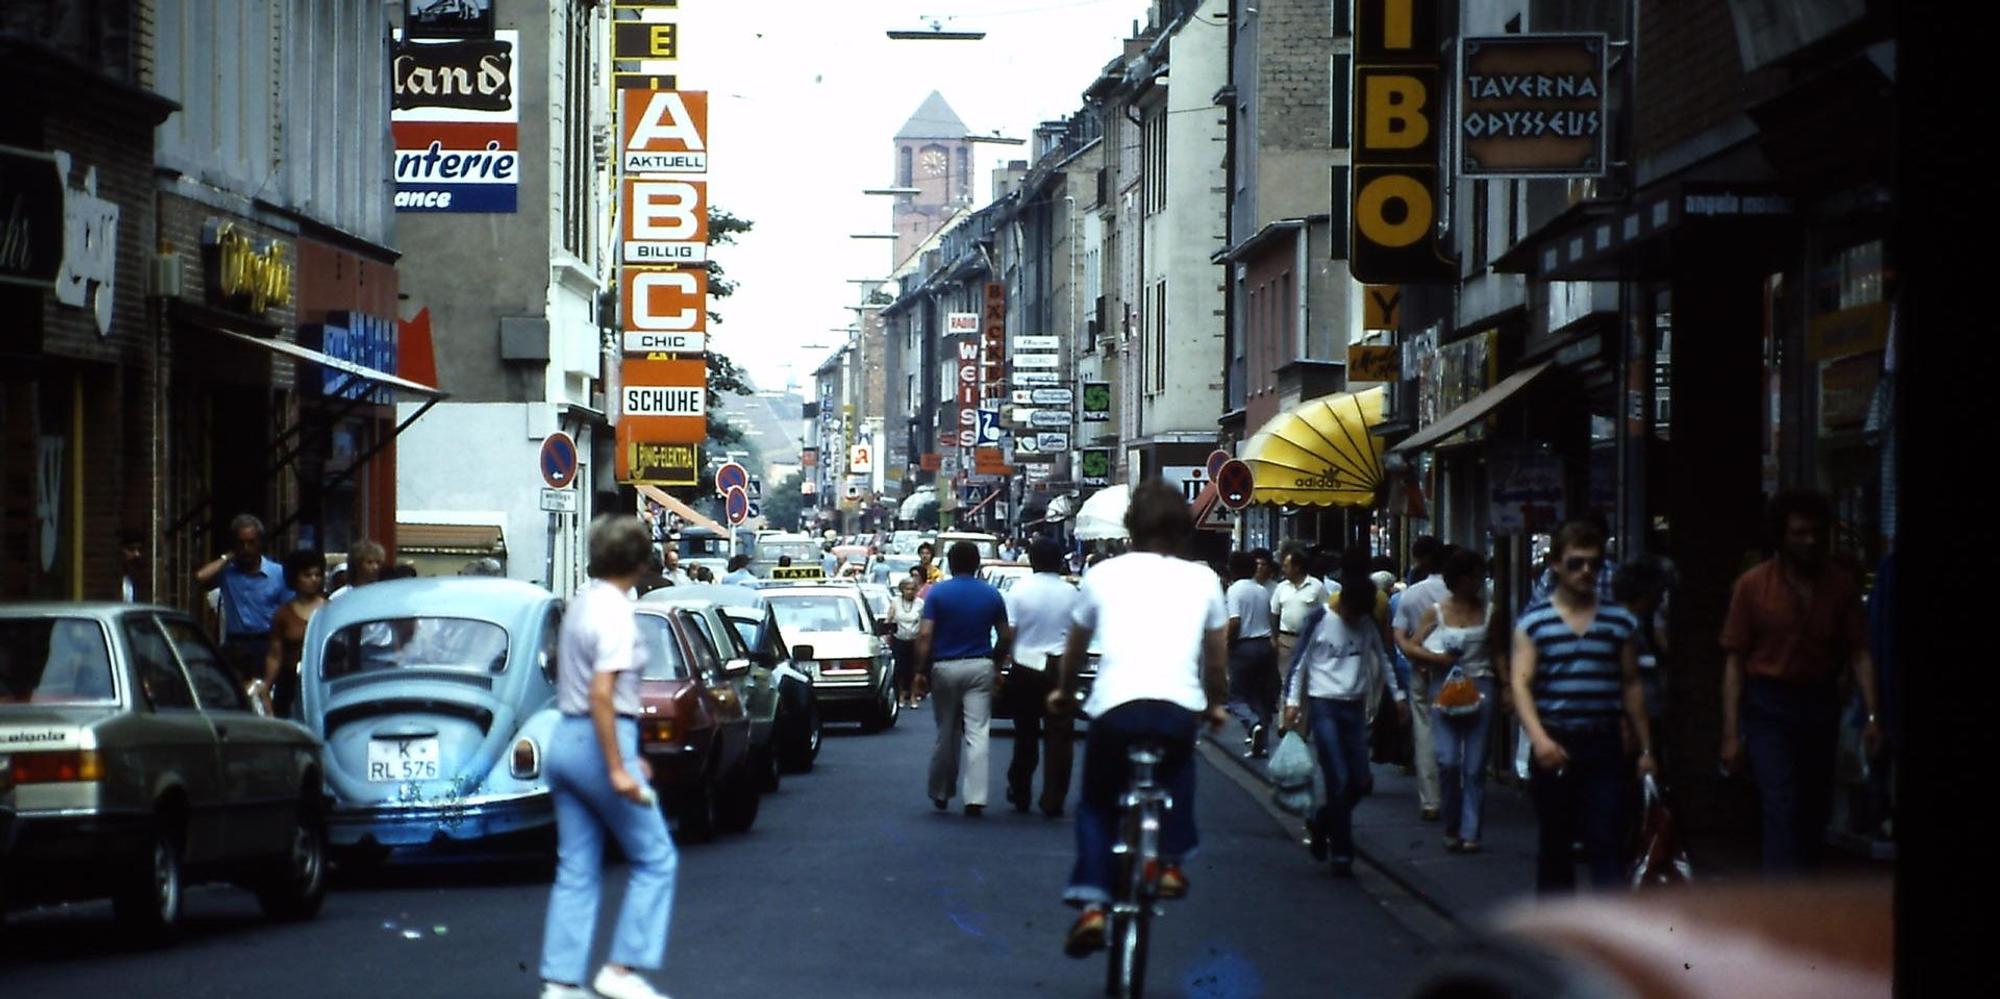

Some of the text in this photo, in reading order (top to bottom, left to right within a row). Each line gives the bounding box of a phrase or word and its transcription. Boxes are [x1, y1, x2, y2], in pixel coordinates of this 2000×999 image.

[1469, 75, 1597, 98] TAVERNA
[627, 93, 704, 150] A
[1463, 111, 1599, 137] ODYSSEUS
[628, 156, 704, 168] AKTUELL
[632, 182, 699, 241] B
[637, 246, 692, 258] BILLIG
[632, 272, 698, 330] C
[951, 317, 977, 329] RADIO
[641, 336, 685, 348] CHIC
[628, 390, 700, 413] SCHUHE
[959, 342, 978, 446] WEISS
[1295, 477, 1342, 489] adidas
[781, 569, 814, 579] TAXI
[398, 740, 410, 758] K
[371, 761, 436, 779] RL 576
